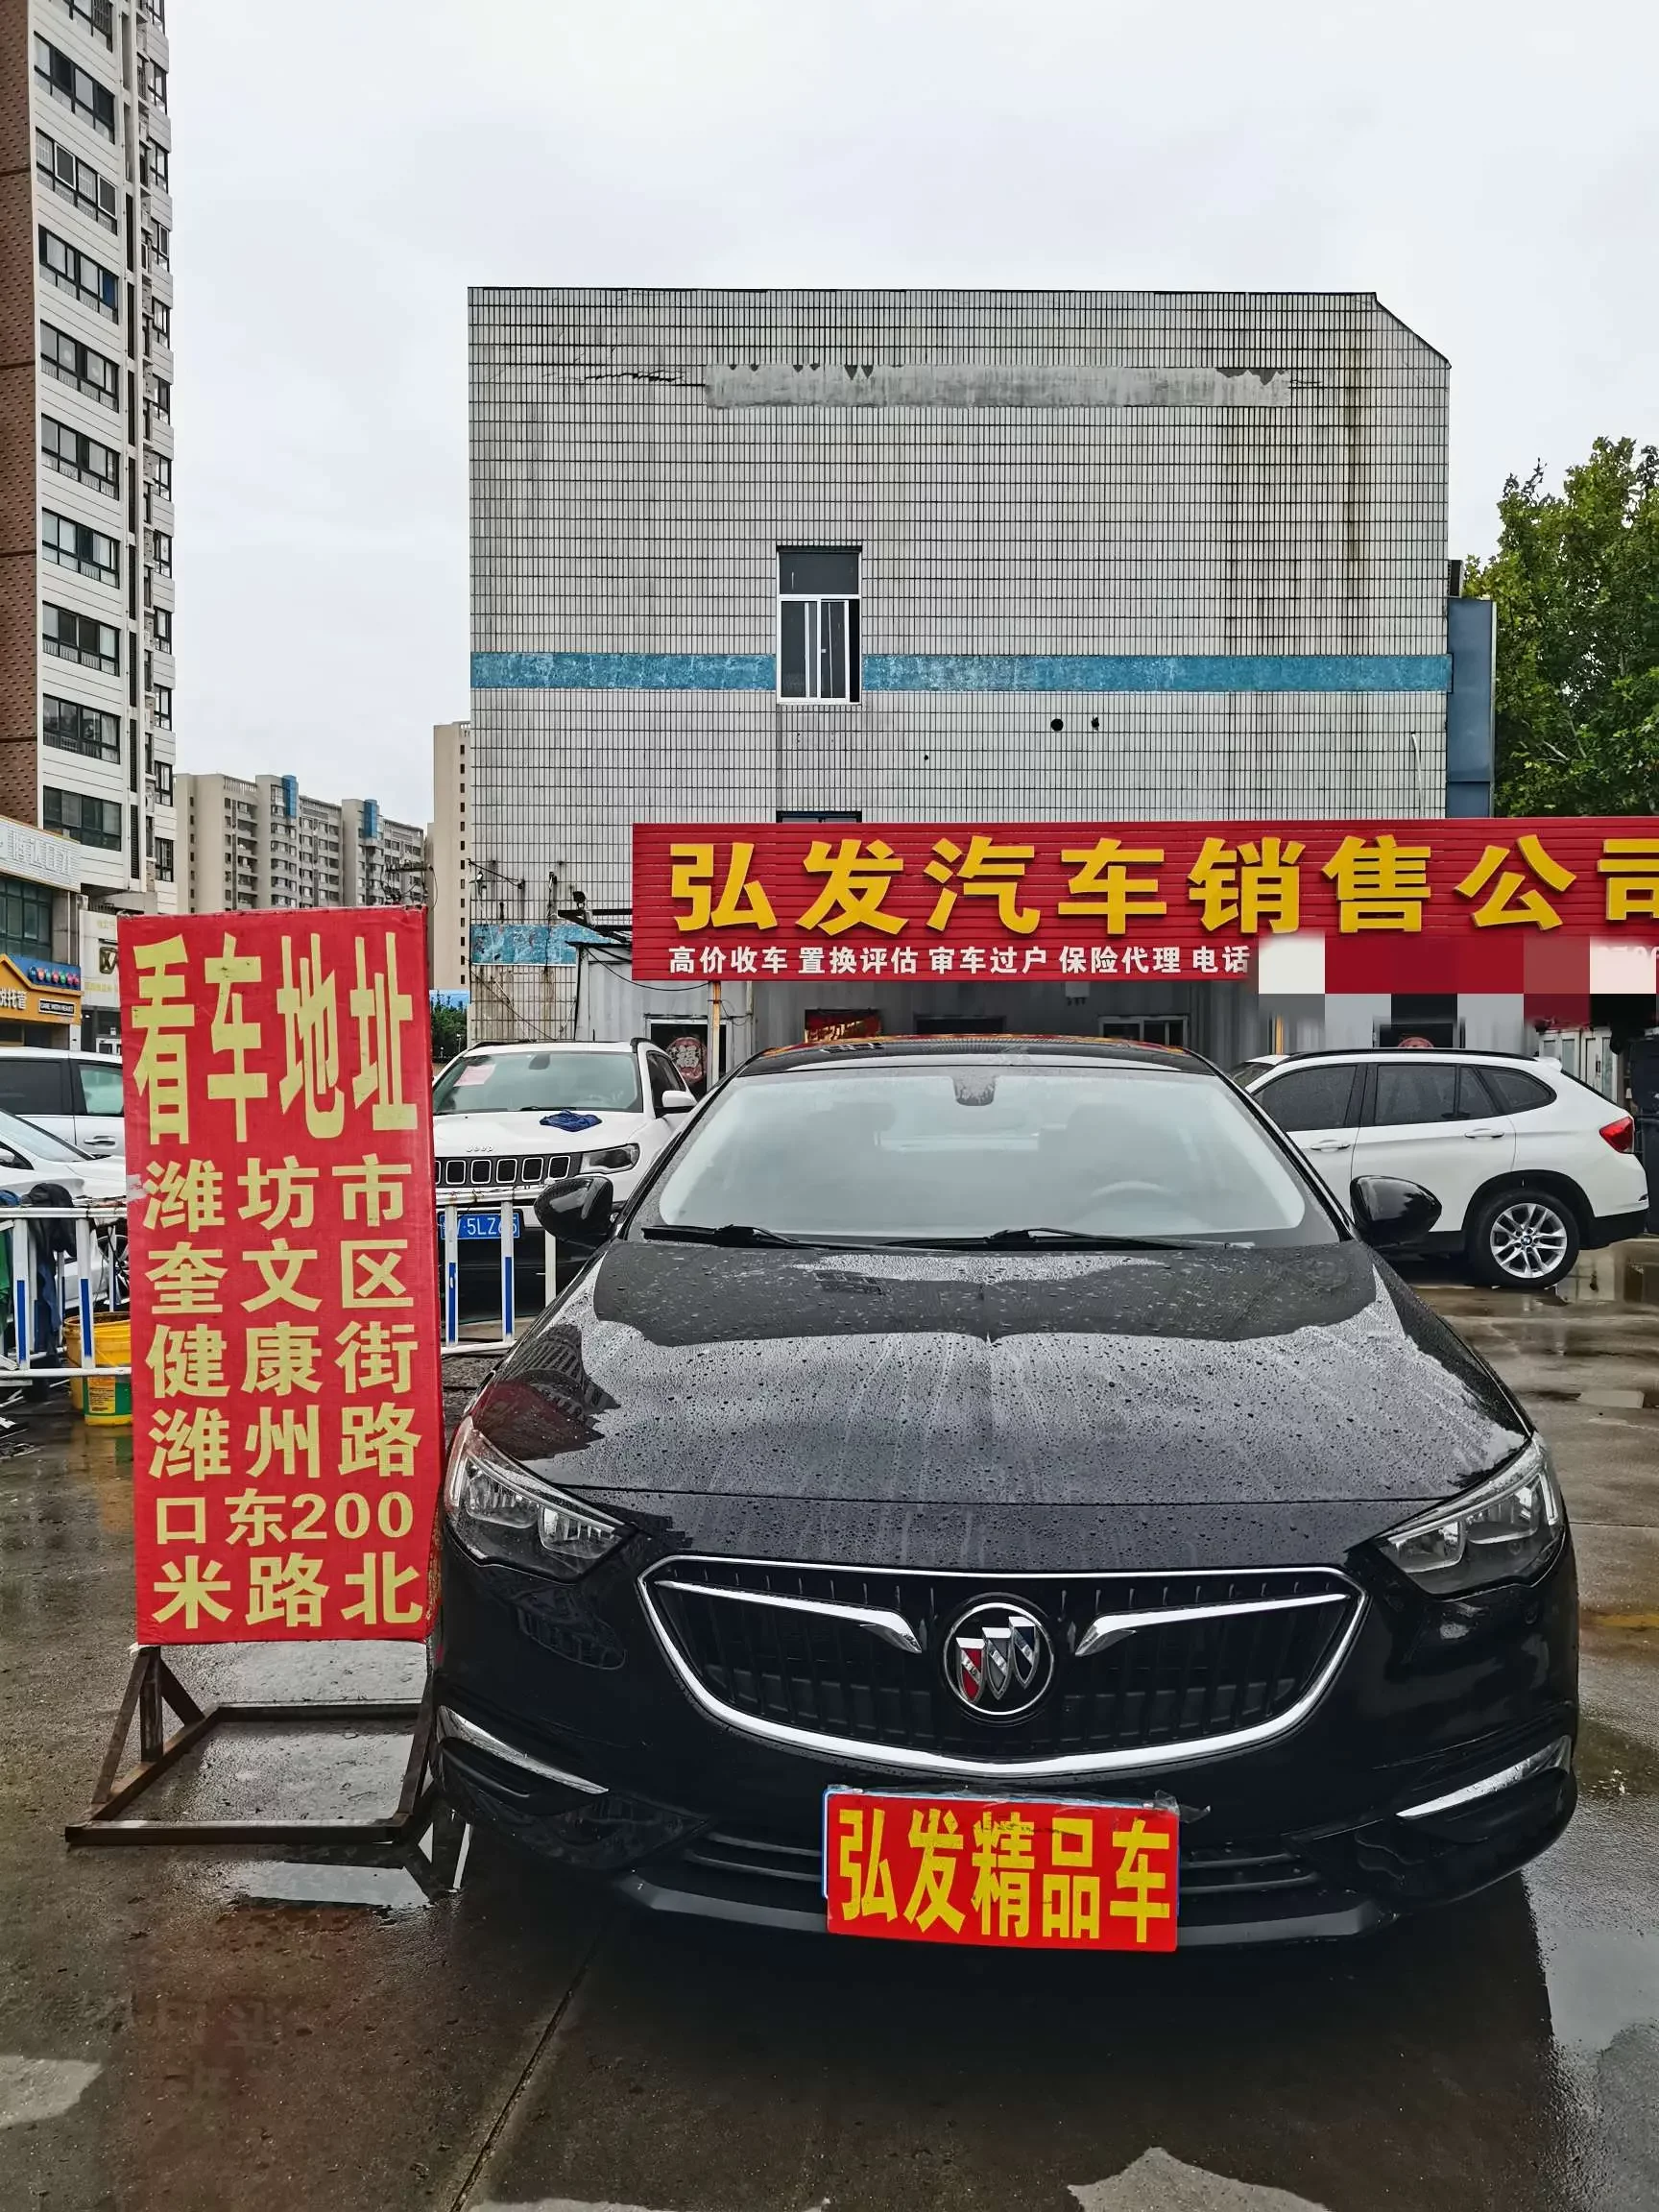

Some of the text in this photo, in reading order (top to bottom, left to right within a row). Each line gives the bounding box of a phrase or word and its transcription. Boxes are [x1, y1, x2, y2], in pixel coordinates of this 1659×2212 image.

[670, 834, 1659, 935] 弘发汽车销售公司
[669, 946, 1249, 974] 高价收车 置换评估 审车过户 保险代理 电话
[132, 932, 419, 1144] 看车地址
[142, 1154, 413, 1234] 潍坊市
[146, 1239, 414, 1316] 奎文区
[146, 1320, 419, 1399] 健康街
[148, 1402, 421, 1482] 潍州路
[156, 1488, 413, 1547] 口东200
[154, 1551, 423, 1629] 米路北
[839, 1808, 1170, 1942] 弘发精品车
